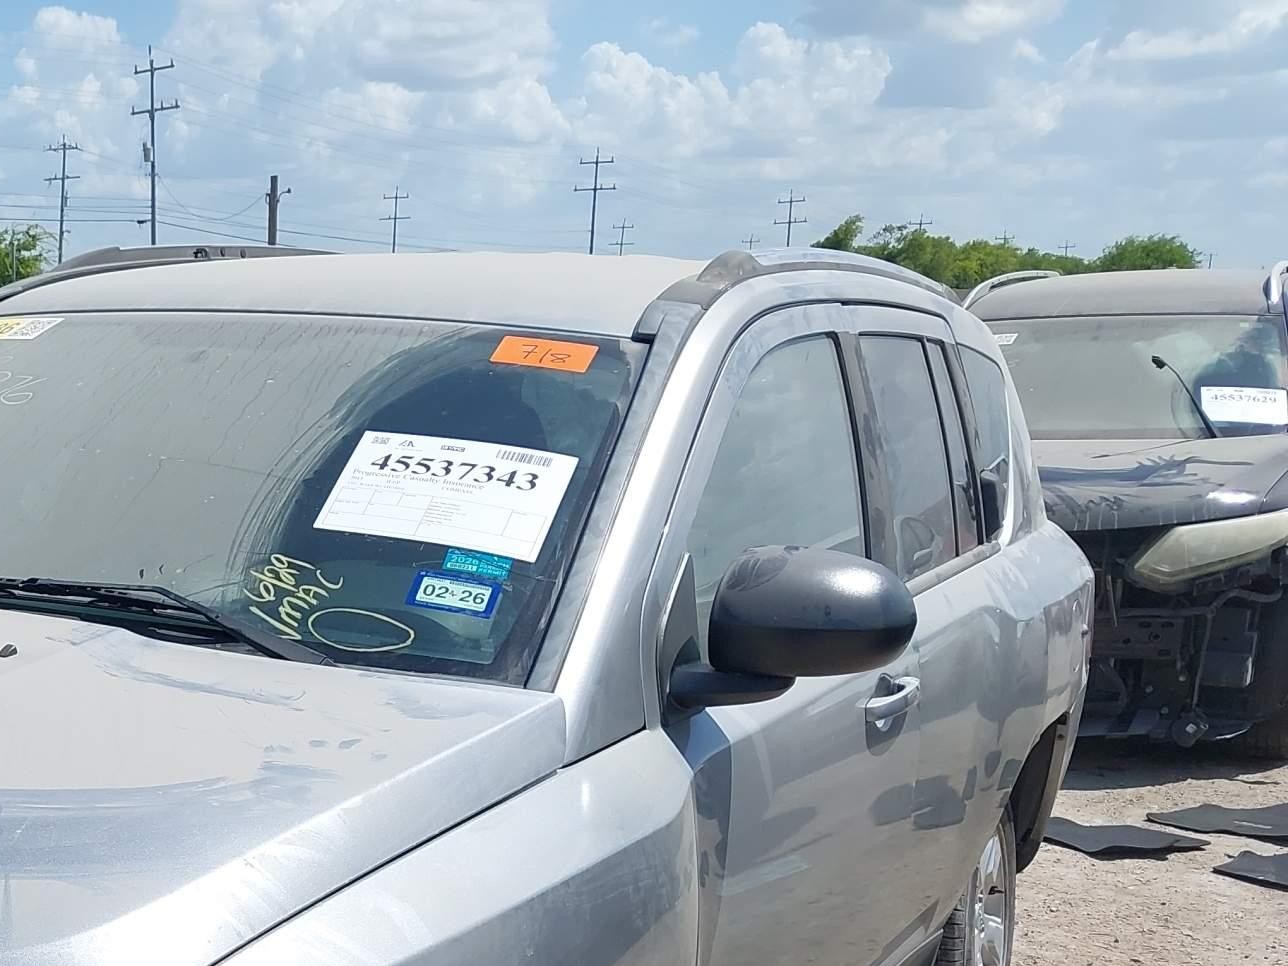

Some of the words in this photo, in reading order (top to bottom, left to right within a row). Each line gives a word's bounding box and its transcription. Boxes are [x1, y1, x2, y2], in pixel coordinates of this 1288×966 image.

[521, 344, 571, 364] 7/8
[370, 453, 540, 492] 45537343
[422, 583, 450, 600] 02
[458, 589, 487, 606] 26
